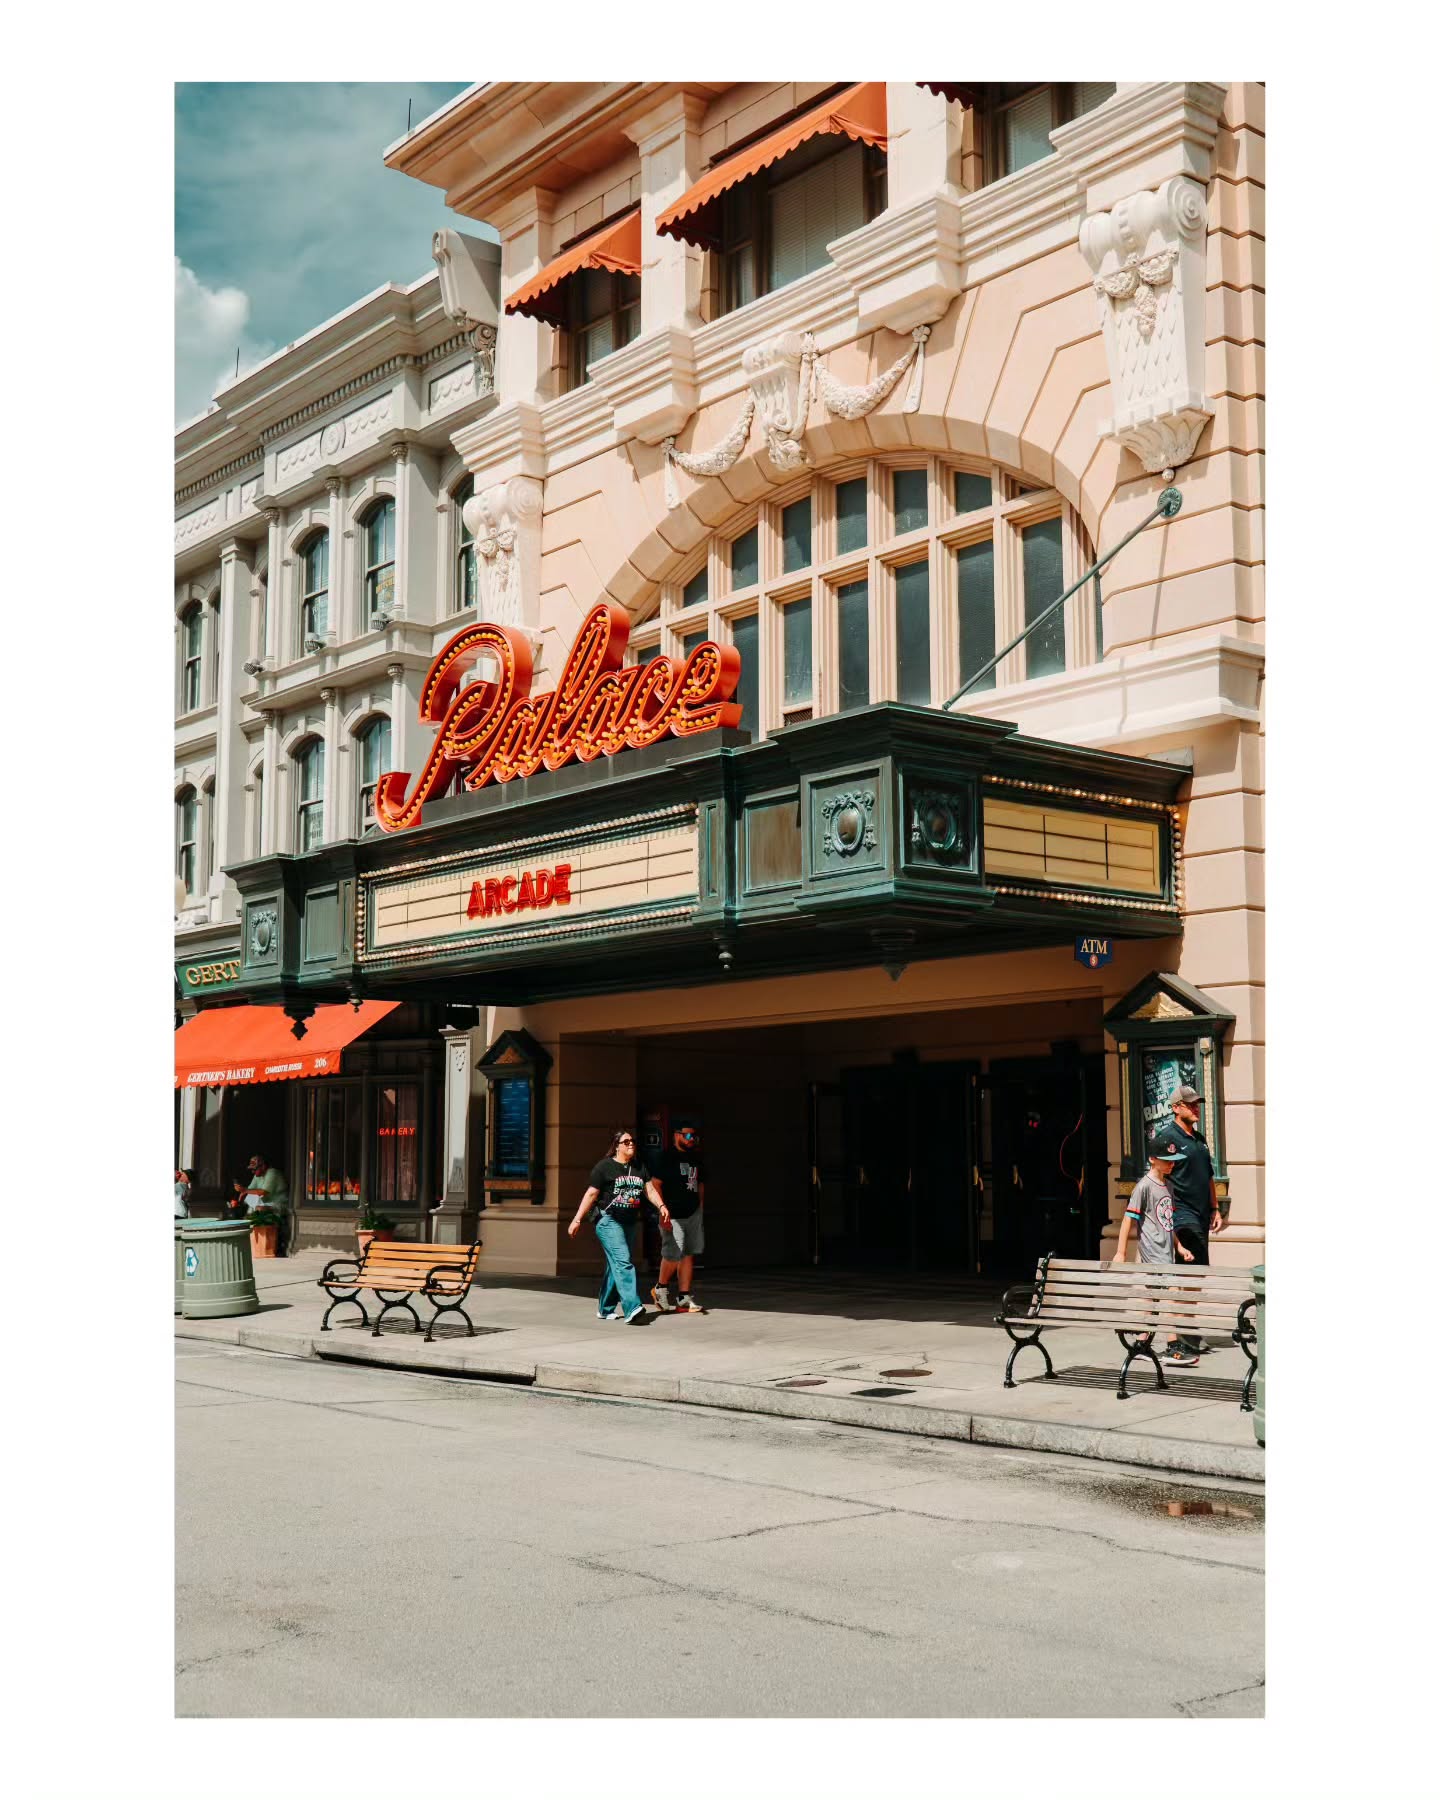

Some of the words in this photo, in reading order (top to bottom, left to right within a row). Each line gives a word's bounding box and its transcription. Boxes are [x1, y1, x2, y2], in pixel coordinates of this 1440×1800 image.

[375, 604, 743, 833] Palace
[467, 863, 571, 920] ARCADE
[1080, 938, 1108, 955] ATM
[314, 1057, 327, 1069] 206
[226, 1067, 256, 1080] BAKERY
[1143, 1100, 1173, 1121] BLAC
